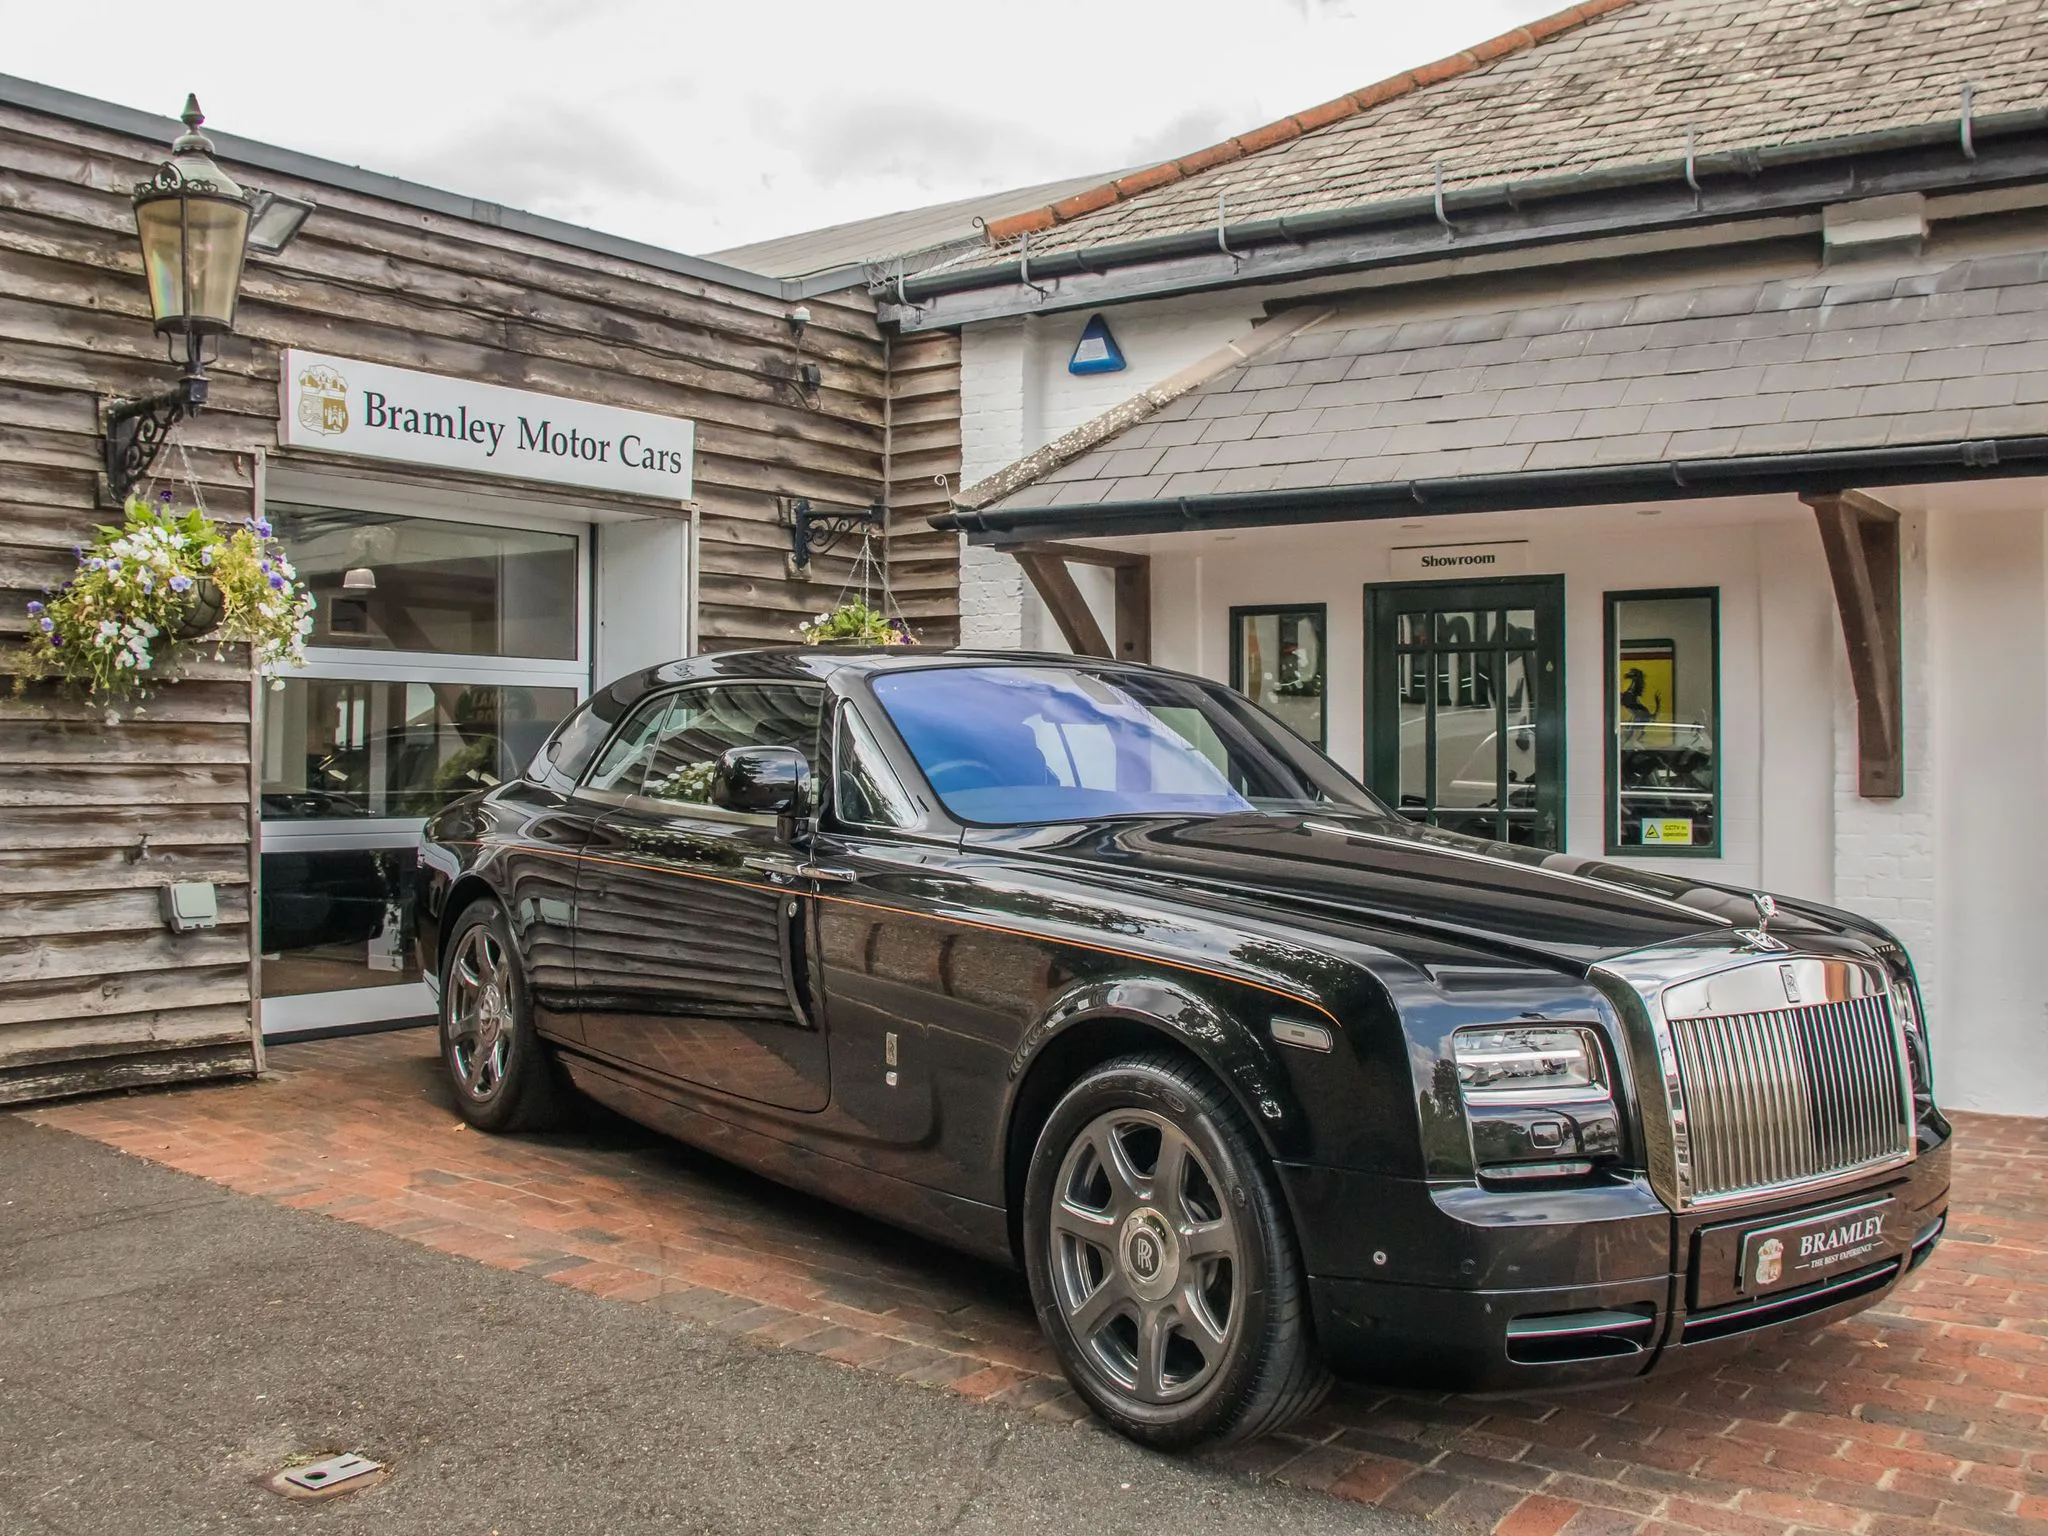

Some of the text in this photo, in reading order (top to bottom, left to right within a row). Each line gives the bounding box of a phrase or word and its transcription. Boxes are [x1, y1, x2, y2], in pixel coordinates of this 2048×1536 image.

[363, 390, 683, 475] Bramley Motor Cars
[1421, 554, 1496, 568] Showroom
[1800, 1214, 1884, 1256] BRAMLEY
[1811, 1243, 1873, 1268] THE BEST EXPERIENCE
